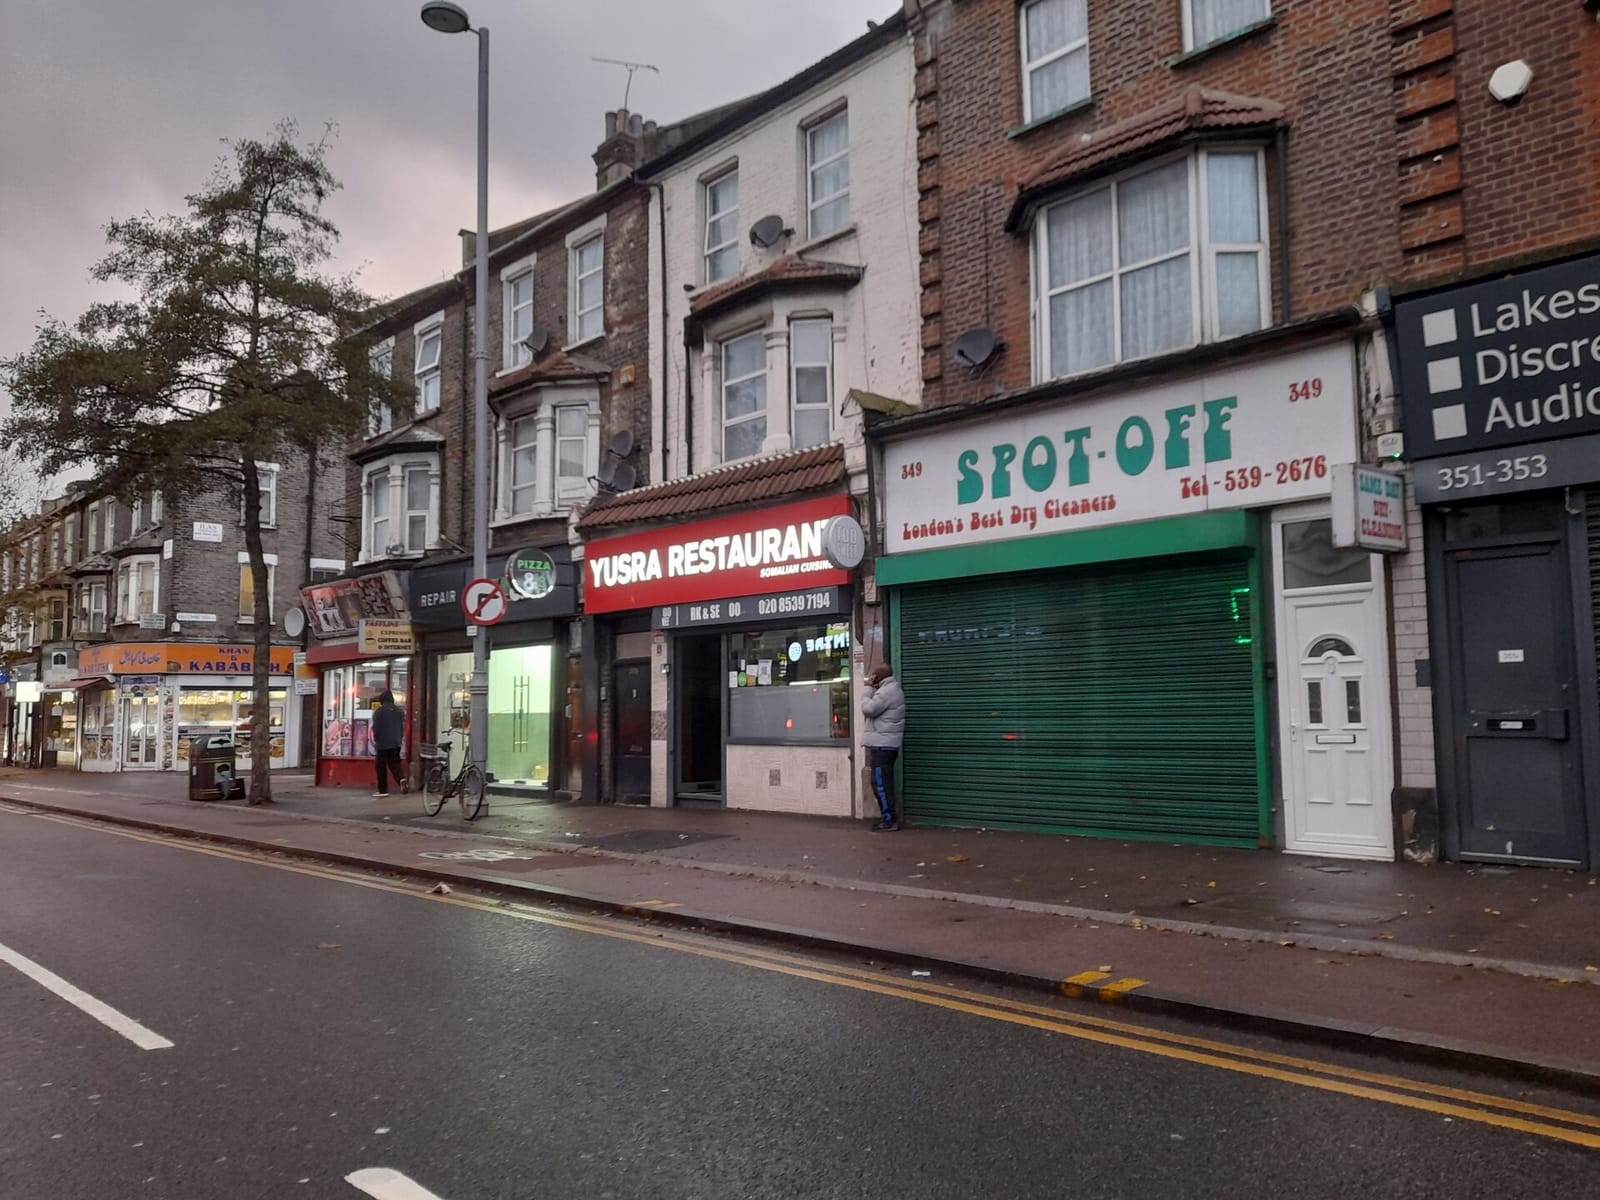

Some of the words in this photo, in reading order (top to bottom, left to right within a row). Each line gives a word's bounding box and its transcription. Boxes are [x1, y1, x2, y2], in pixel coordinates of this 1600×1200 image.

[1471, 283, 1600, 337] Lakes
[1288, 378, 1323, 402] 349
[957, 395, 1238, 505] SPOT-OFF
[901, 462, 923, 480] 349
[1437, 454, 1548, 491] 351-353
[903, 516, 964, 540] London's
[970, 509, 1004, 531] Best
[1010, 505, 1037, 530] Dry
[1044, 494, 1117, 519] Cleaners
[517, 559, 552, 571] PIZZA
[590, 549, 663, 588] YUSRA
[760, 563, 800, 578] SOMALIAN
[421, 590, 457, 607] REPAIR
[758, 598, 777, 615] 020
[778, 595, 805, 612] 8539
[805, 592, 830, 609] 7194
[189, 661, 280, 672] KABABH
